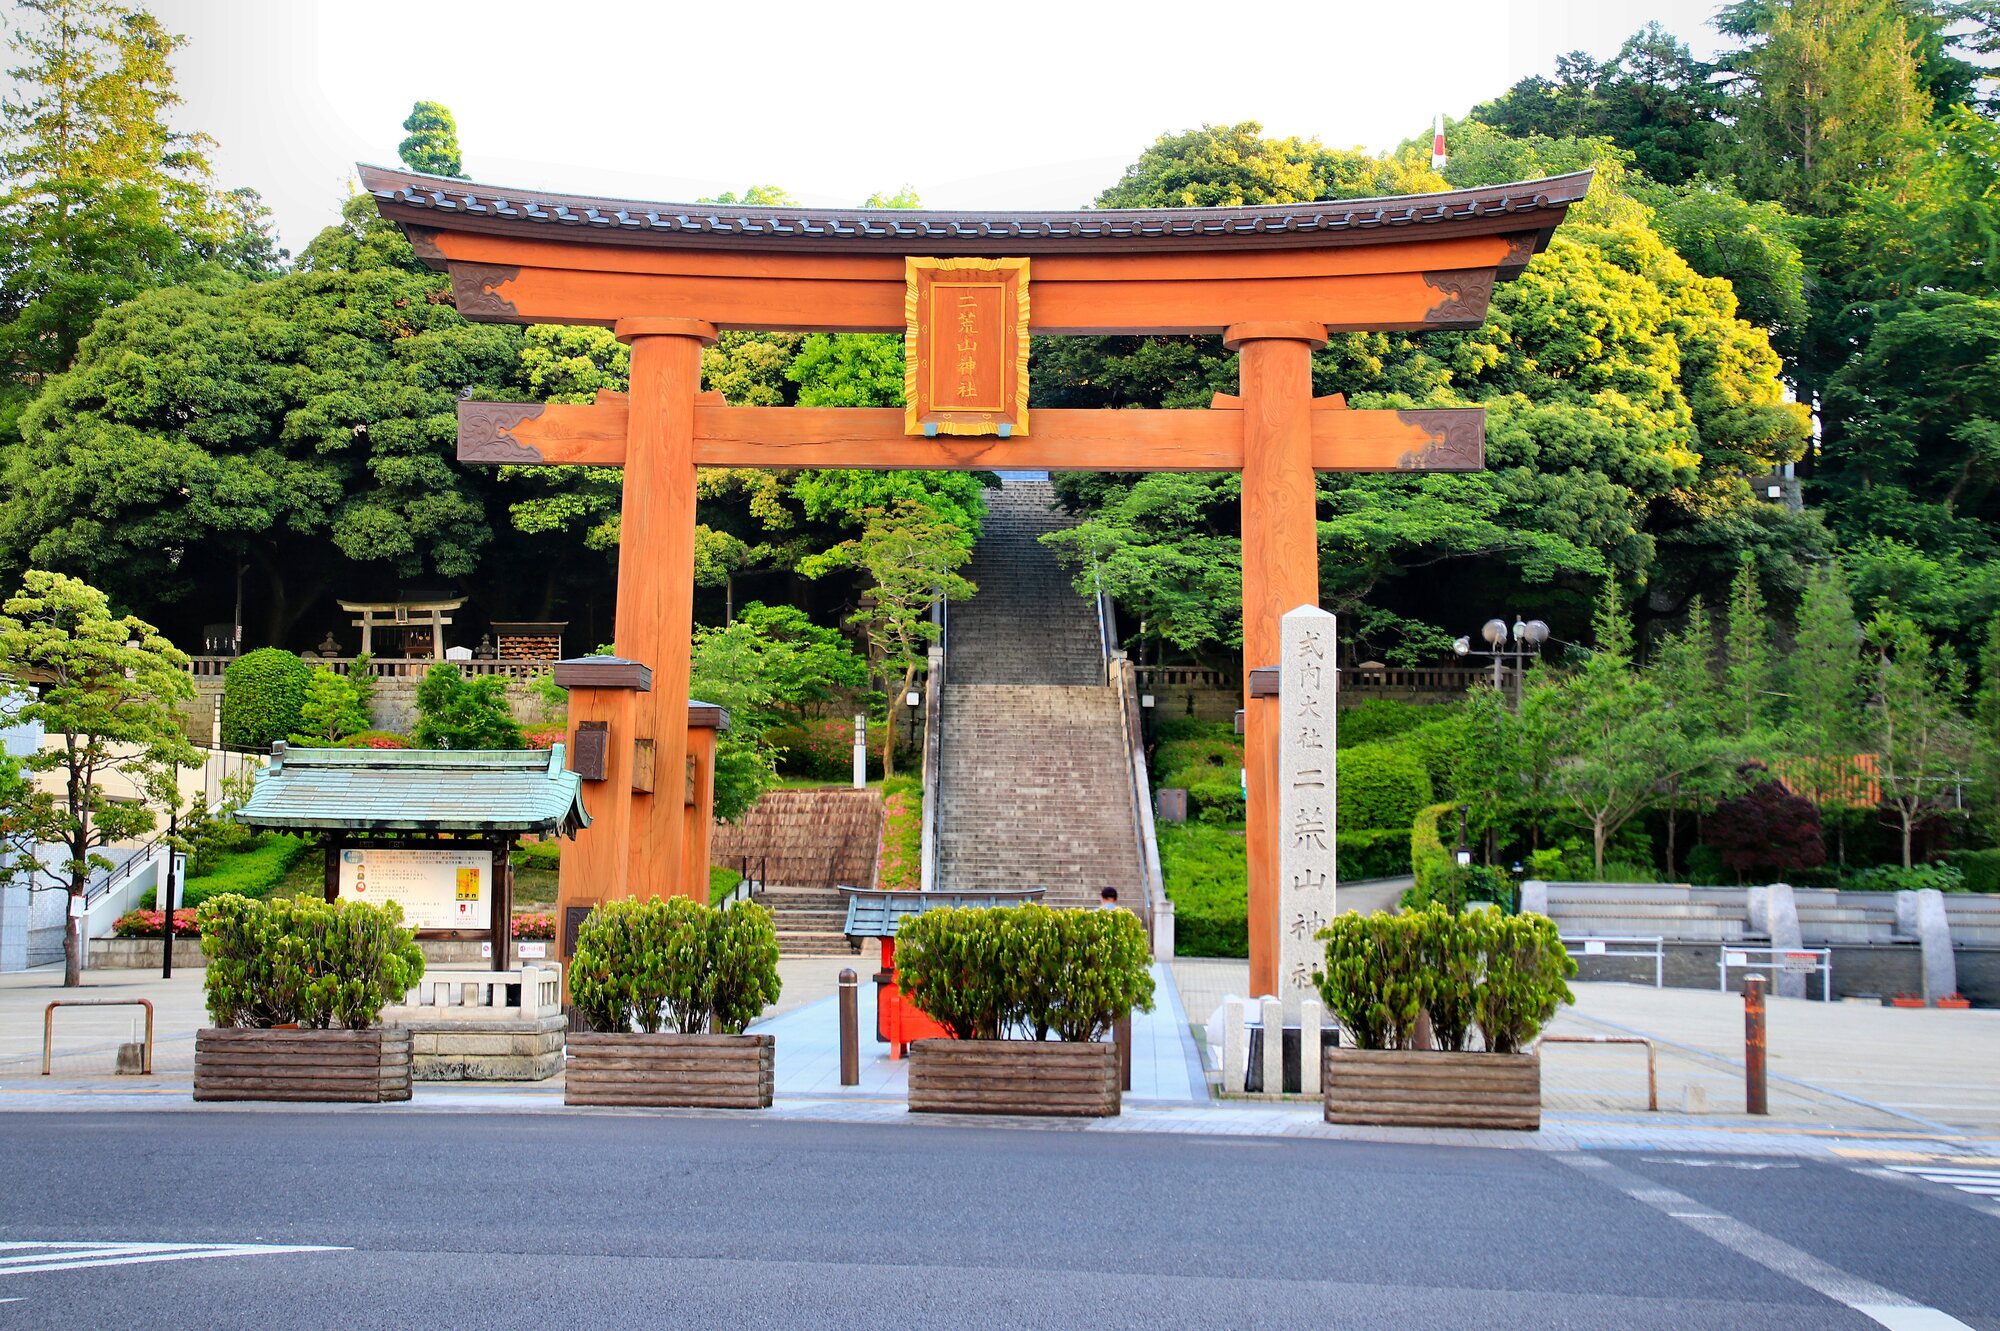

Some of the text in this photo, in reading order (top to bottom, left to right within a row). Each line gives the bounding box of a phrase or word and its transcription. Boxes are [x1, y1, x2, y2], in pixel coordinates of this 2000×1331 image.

[957, 295, 979, 398] 二荒山神社
